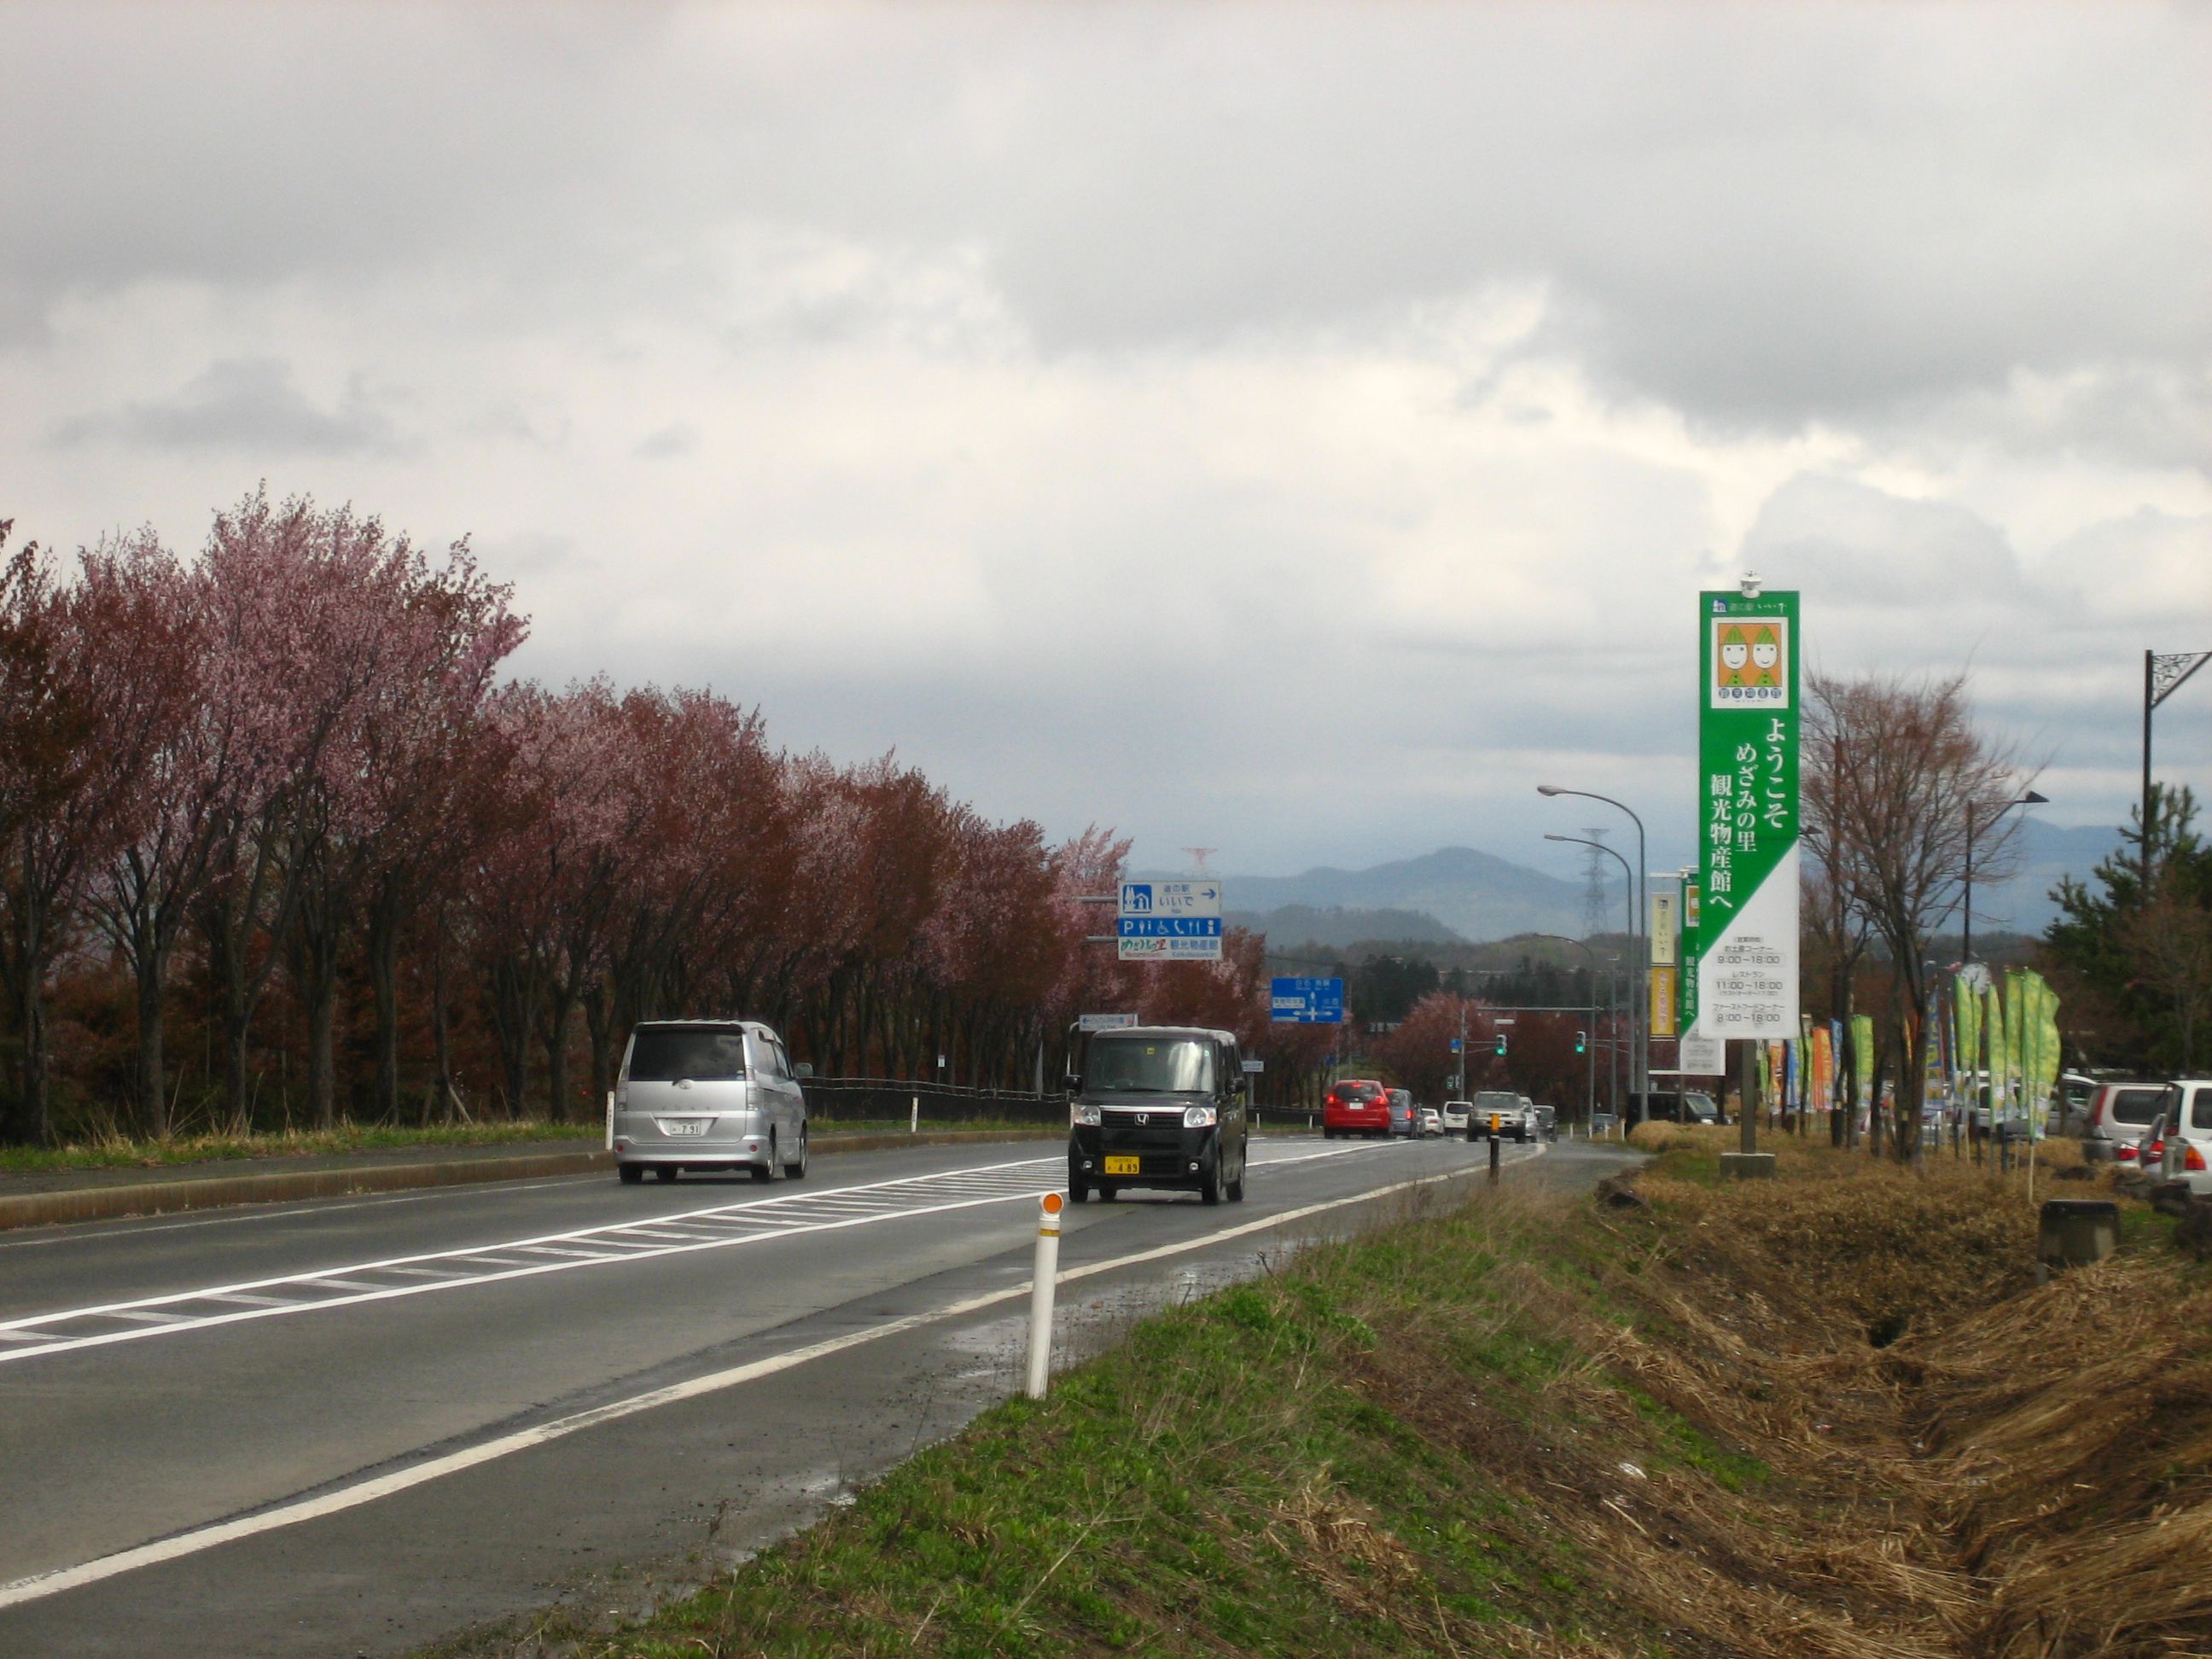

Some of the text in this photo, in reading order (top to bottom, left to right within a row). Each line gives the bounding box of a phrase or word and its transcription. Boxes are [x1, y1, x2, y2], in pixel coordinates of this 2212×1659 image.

[1735, 742, 1758, 853] めざみの里
[1762, 718, 1790, 830] ようこそ
[1708, 774, 1734, 909] 観光物産館へ
[1159, 896, 1194, 907] いいで
